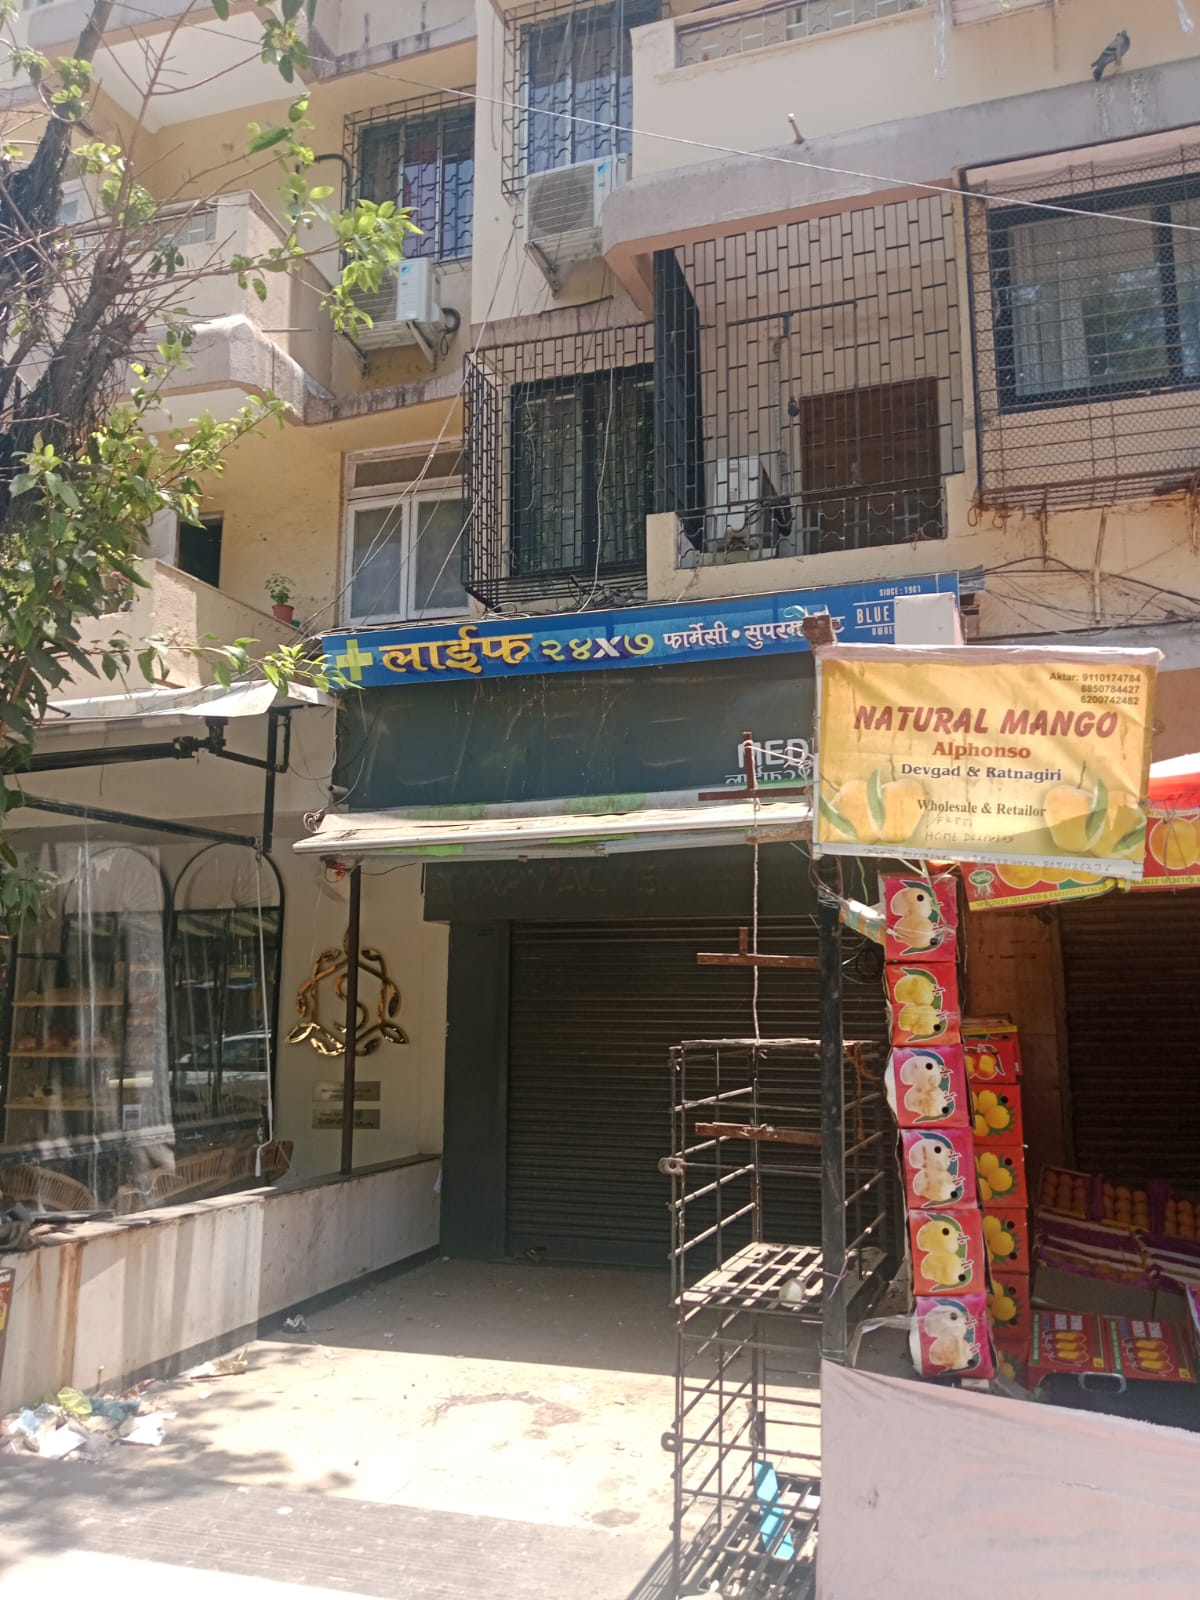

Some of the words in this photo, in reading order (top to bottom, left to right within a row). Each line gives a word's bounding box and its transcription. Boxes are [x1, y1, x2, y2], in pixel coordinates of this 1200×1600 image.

[856, 605, 891, 624] BLUE
[378, 625, 533, 674] लाईफ
[662, 620, 729, 649] फार्मेसी
[1049, 672, 1079, 681] Aktar:
[1082, 673, 1141, 683] 9110174784
[853, 705, 989, 735] NATURAL
[1000, 708, 1118, 738] MANGO
[932, 741, 1032, 760] Alphonso
[901, 763, 961, 779] Devgad
[967, 766, 981, 777] &
[986, 766, 1062, 783] Ratnagiri
[917, 799, 977, 814] Wholesale
[981, 802, 992, 814] &
[996, 803, 1047, 817] Retailor
